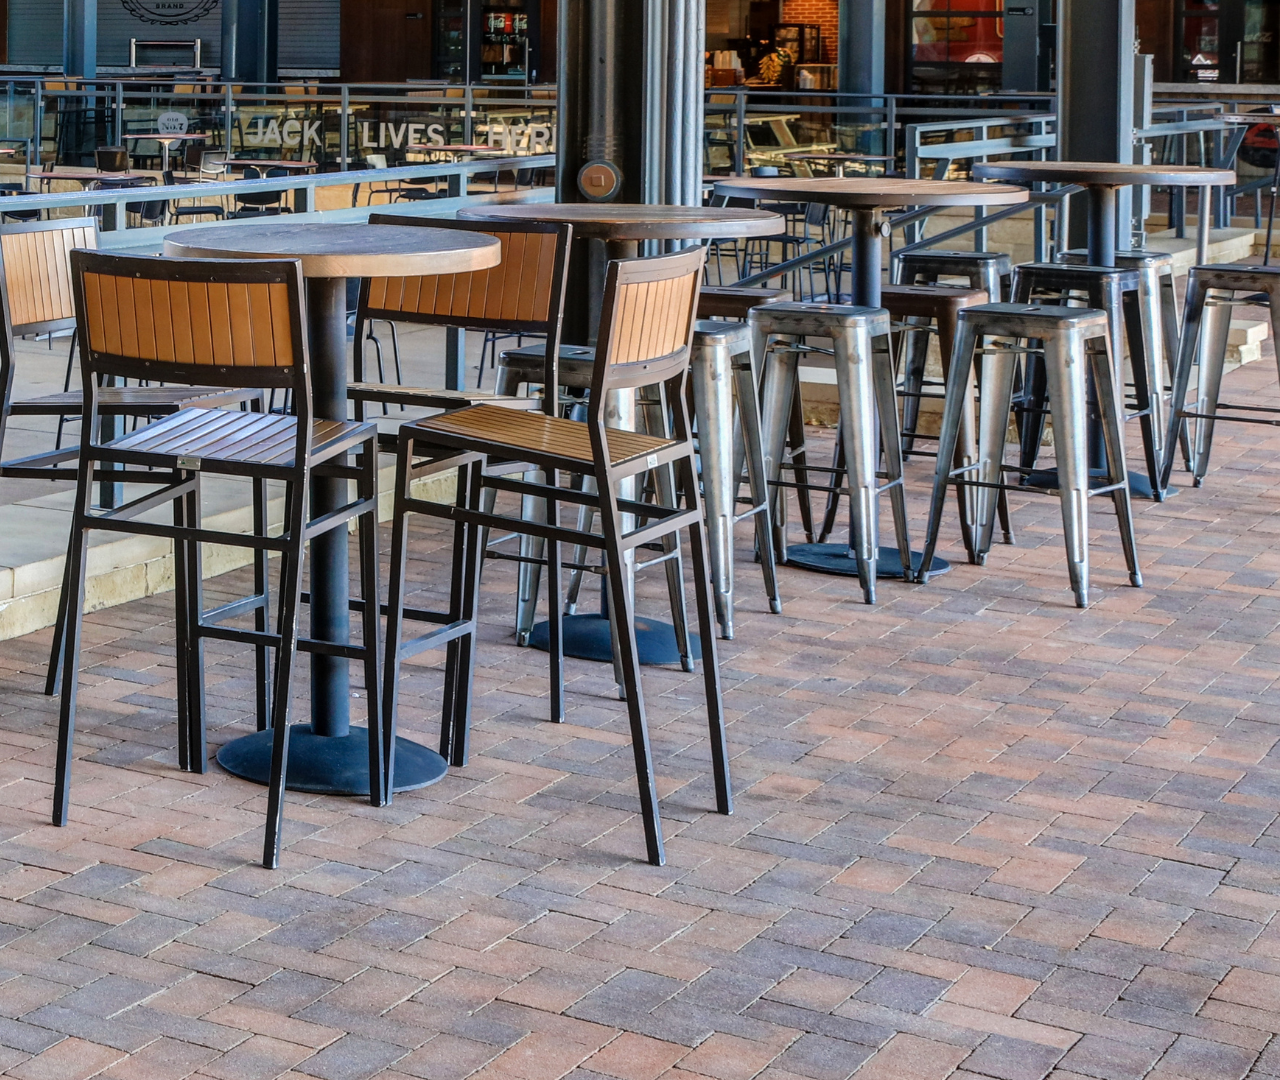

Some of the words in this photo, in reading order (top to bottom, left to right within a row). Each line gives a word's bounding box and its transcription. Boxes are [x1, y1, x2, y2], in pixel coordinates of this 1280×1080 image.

[155, 2, 185, 10] BRAND
[247, 119, 322, 146] JACK
[362, 121, 445, 150] LIVES
